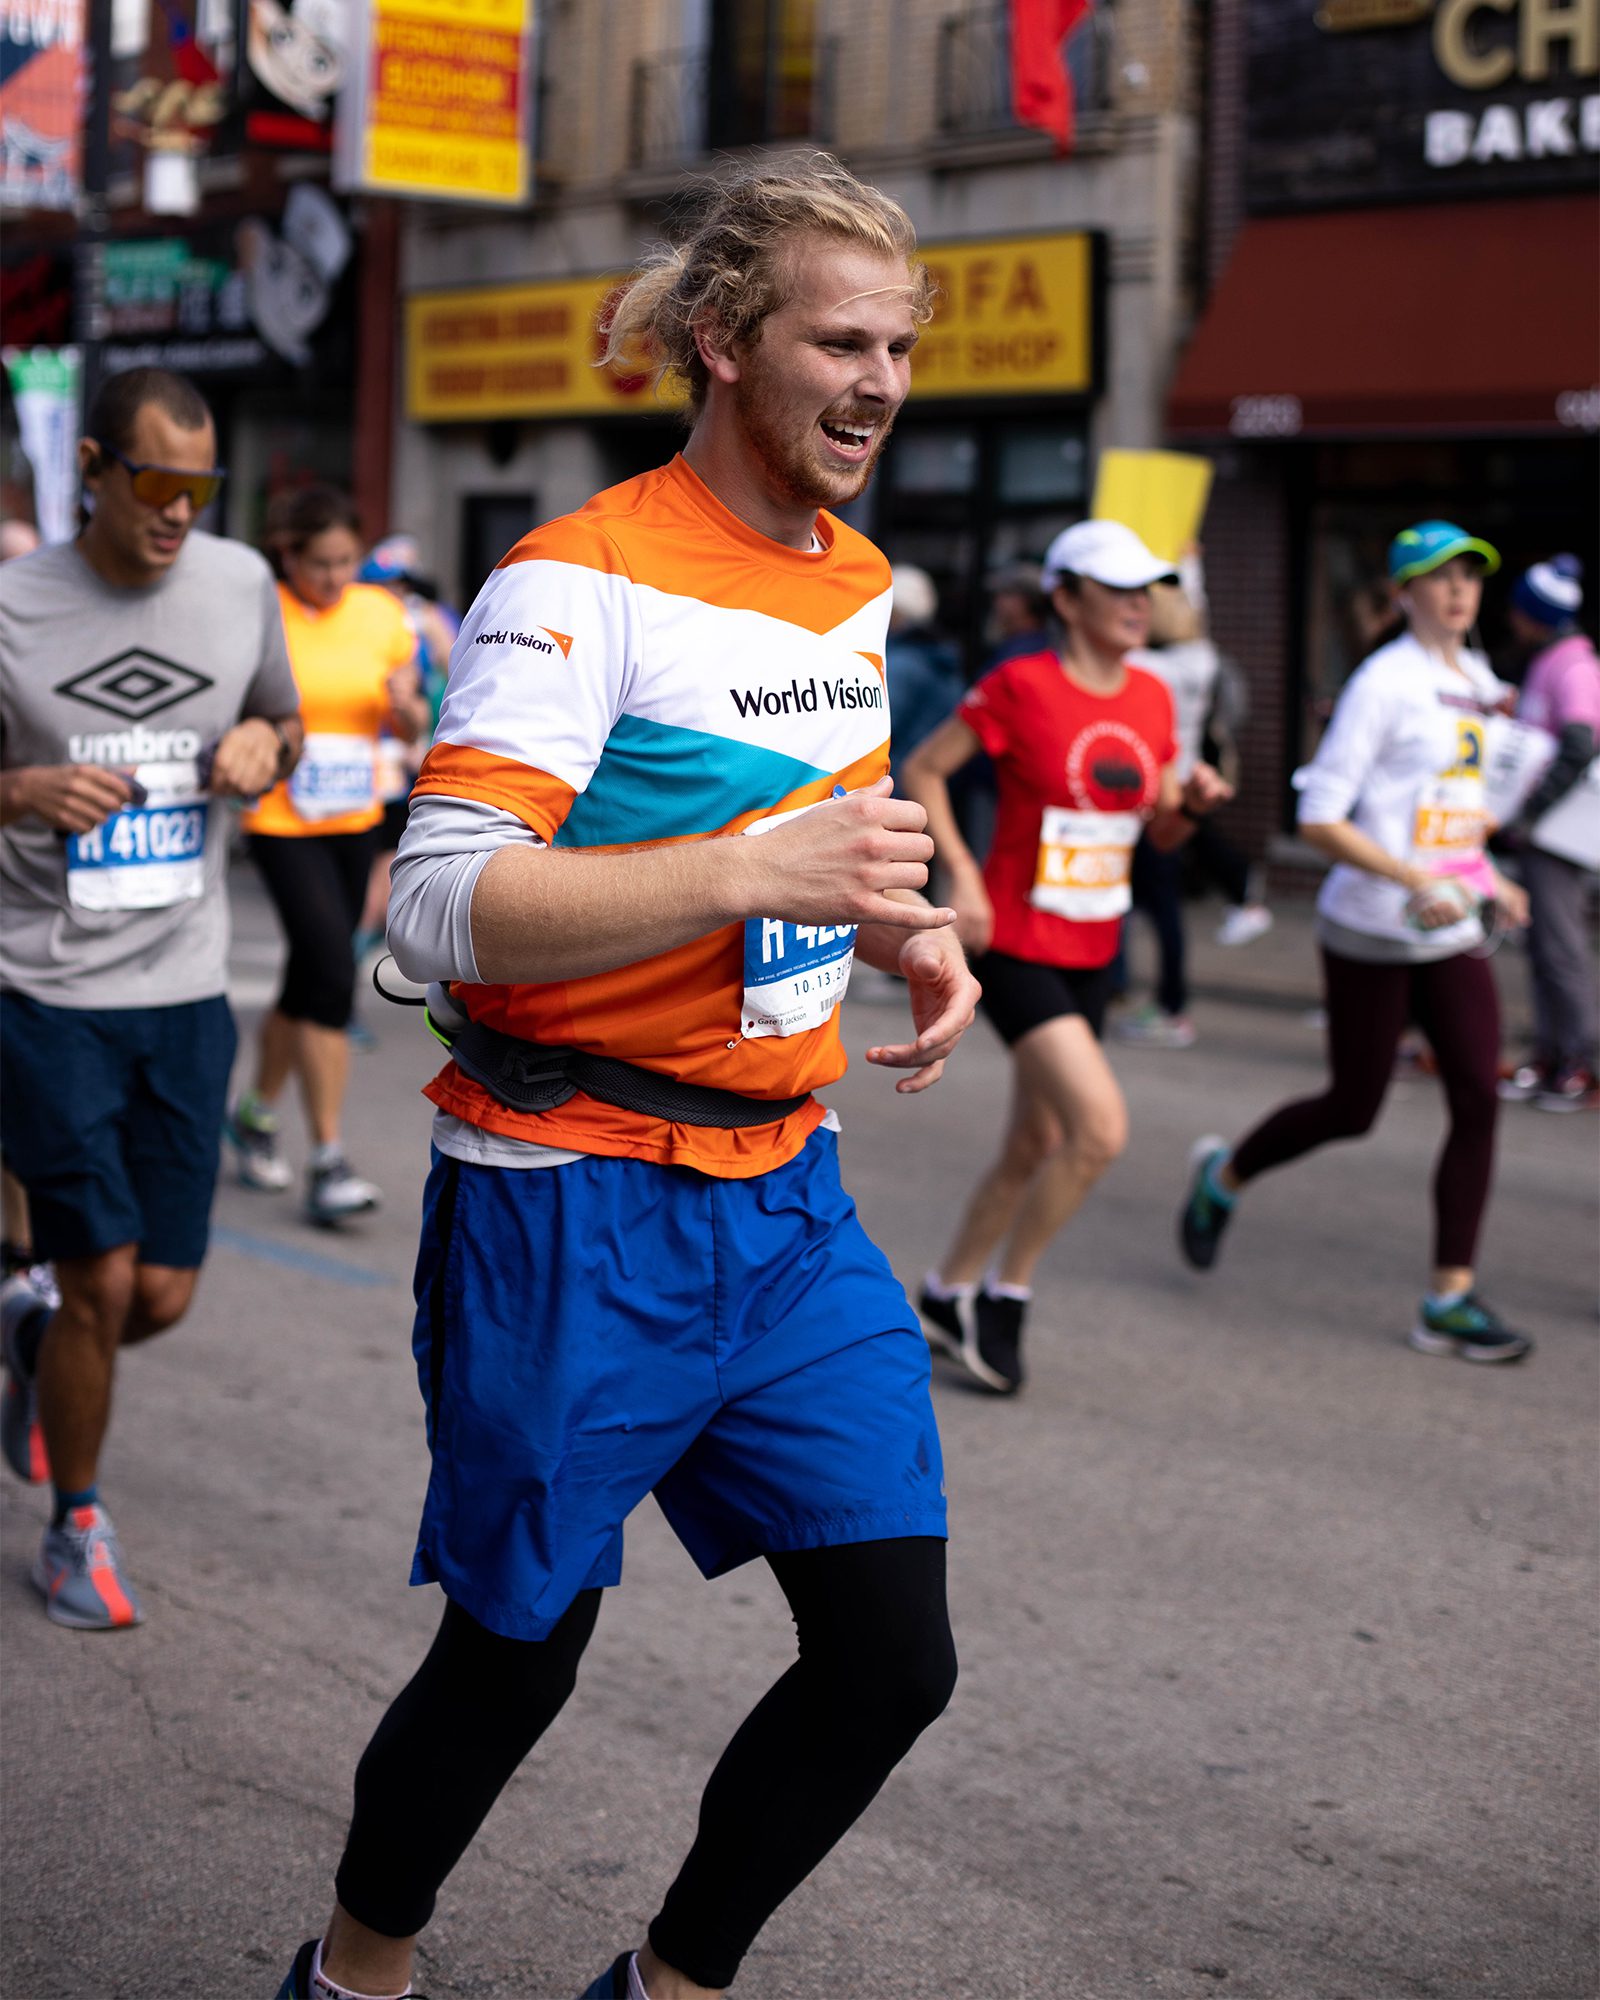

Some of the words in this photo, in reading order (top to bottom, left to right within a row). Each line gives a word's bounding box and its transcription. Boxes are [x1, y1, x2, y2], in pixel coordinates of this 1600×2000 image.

[966, 330, 1061, 376] SHOP
[510, 632, 553, 655] Vision
[729, 678, 818, 719] World
[822, 677, 883, 710] Vision
[69, 726, 200, 763] umbro
[110, 810, 201, 860] 41023
[757, 1017, 778, 1026] Gate
